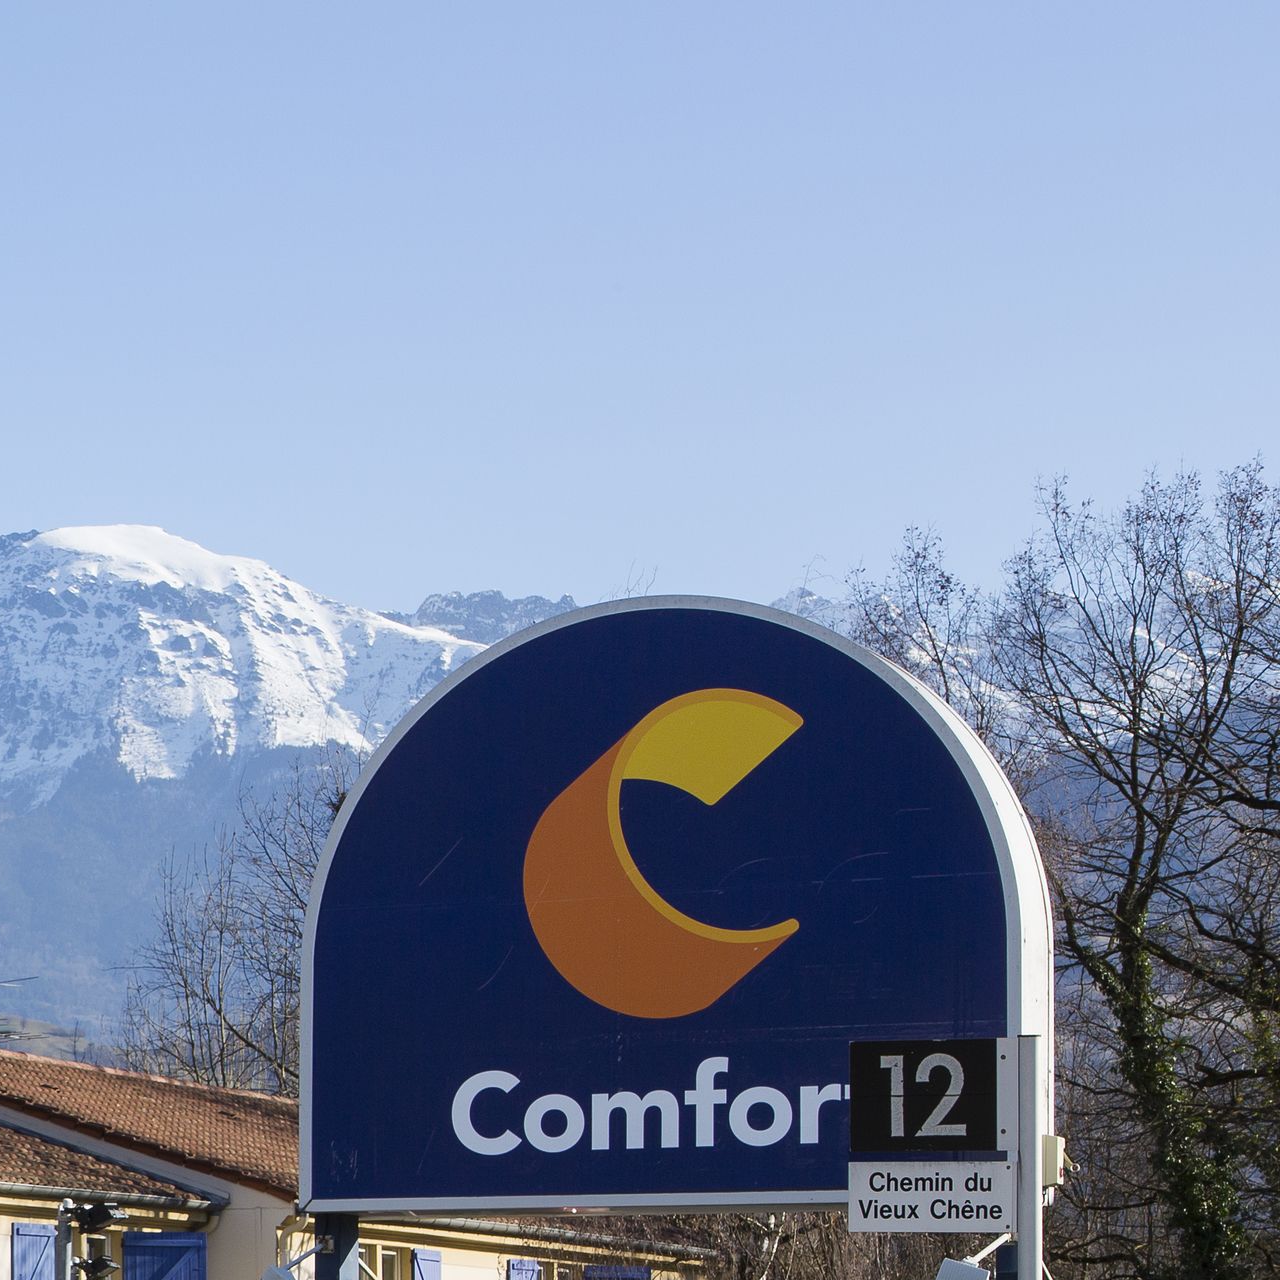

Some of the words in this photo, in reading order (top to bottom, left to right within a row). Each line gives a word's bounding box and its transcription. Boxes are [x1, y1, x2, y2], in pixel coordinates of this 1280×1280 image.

[451, 1056, 851, 1156] Comfor
[880, 1053, 967, 1137] 12
[868, 1171, 954, 1193] Chemin
[964, 1171, 993, 1193] du
[857, 1199, 920, 1220] Vieux
[929, 1198, 1003, 1220] Chêne
